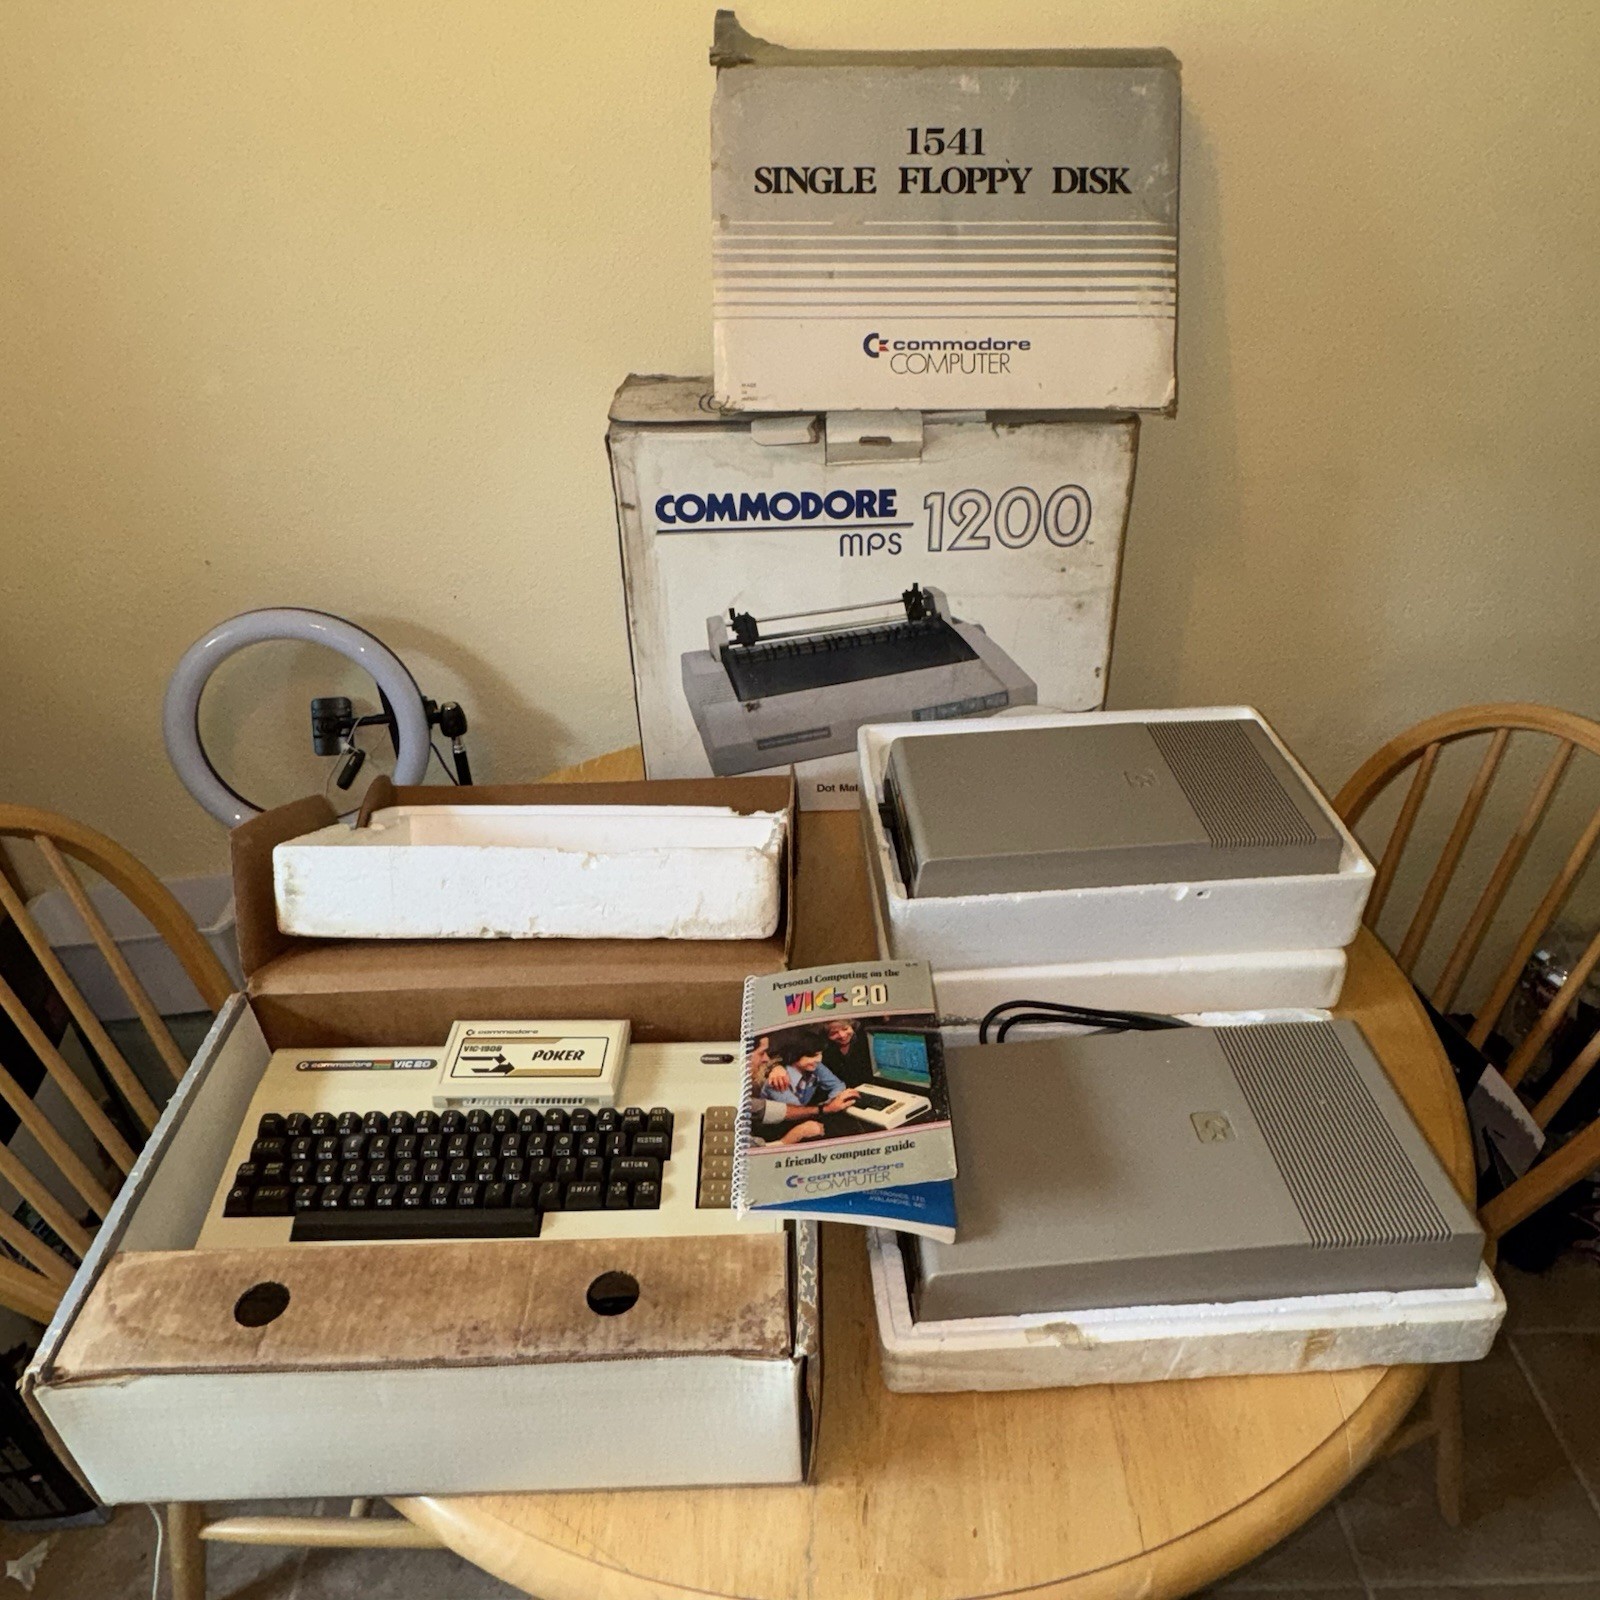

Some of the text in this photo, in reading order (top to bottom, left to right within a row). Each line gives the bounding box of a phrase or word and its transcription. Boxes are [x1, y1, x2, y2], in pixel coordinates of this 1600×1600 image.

[906, 127, 986, 156] 1541
[754, 166, 1133, 195] SINGLE FLOPPY DISK
[893, 337, 1031, 351] commodore
[890, 352, 1011, 374] COMPUTER
[655, 484, 1092, 553] COMMODORE 1200
[816, 783, 836, 793] Dot
[772, 975, 813, 991] Personal
[815, 970, 869, 984] Computing
[884, 968, 900, 978] the
[311, 1061, 373, 1069] commodore
[393, 1060, 413, 1068] VIC
[531, 1049, 585, 1061] POKER
[620, 1160, 649, 1169] RETURN
[774, 1139, 916, 1169] a friendly computer guide
[804, 1171, 891, 1194] COMPUTER
[807, 1162, 905, 1182] commodore
[570, 1185, 598, 1193] SHIFT
